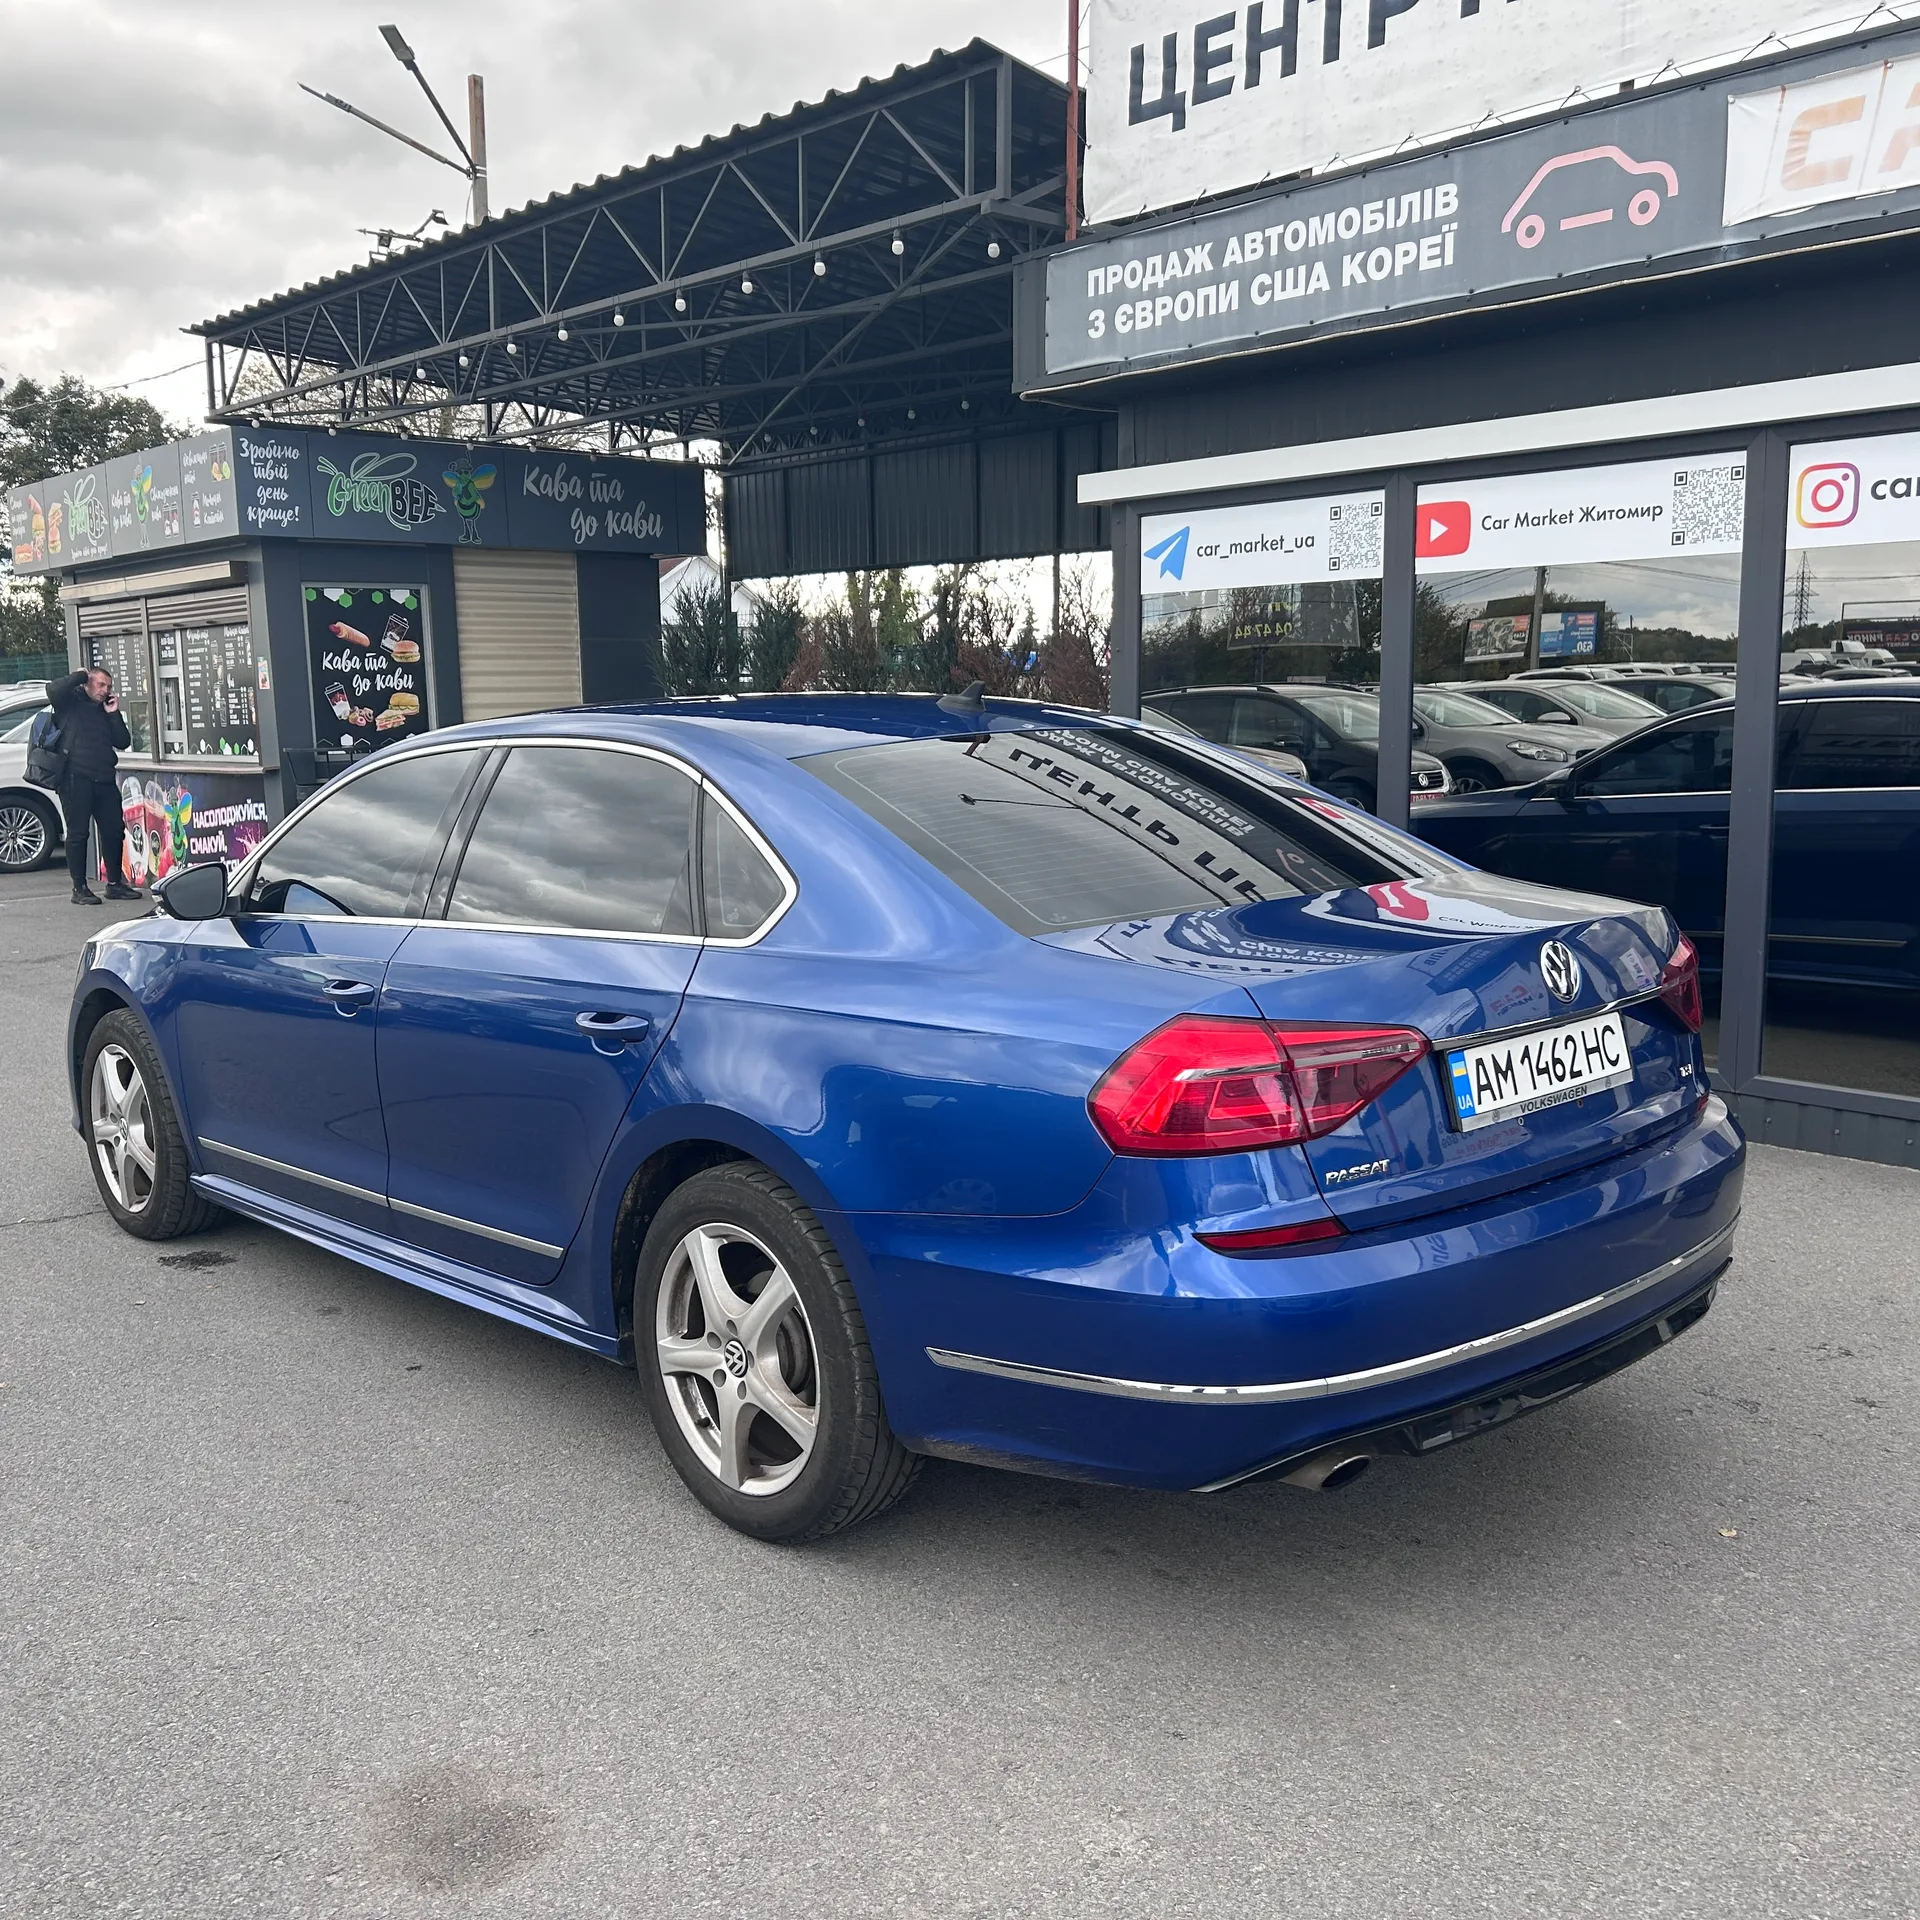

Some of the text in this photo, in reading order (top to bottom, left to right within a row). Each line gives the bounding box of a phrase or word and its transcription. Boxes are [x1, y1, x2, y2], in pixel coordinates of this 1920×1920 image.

[1087, 182, 1459, 298] ПРОДАЖ АВТОМОБІЛІВ
[1087, 221, 1459, 340] З ЄВРОПИ США КОРЕЇ
[239, 437, 300, 465] Зробимо
[253, 461, 289, 481] твій
[523, 462, 624, 503] Кава та
[257, 484, 289, 506] день
[246, 505, 300, 529] краще!
[570, 500, 664, 545] до кави
[1481, 504, 1663, 531] Car Market Житомир
[1197, 533, 1315, 559] car_market_ua
[322, 648, 388, 672] Кава та
[352, 667, 414, 697] до кави
[192, 798, 269, 829] НАСОЛОДЖУЙСЯ,
[189, 830, 228, 855] СМАКУЙ,
[1457, 1095, 1473, 1110] UA
[1519, 1084, 1588, 1114] VOLKSWAGEN
[1325, 1158, 1390, 1186] PASSAT
